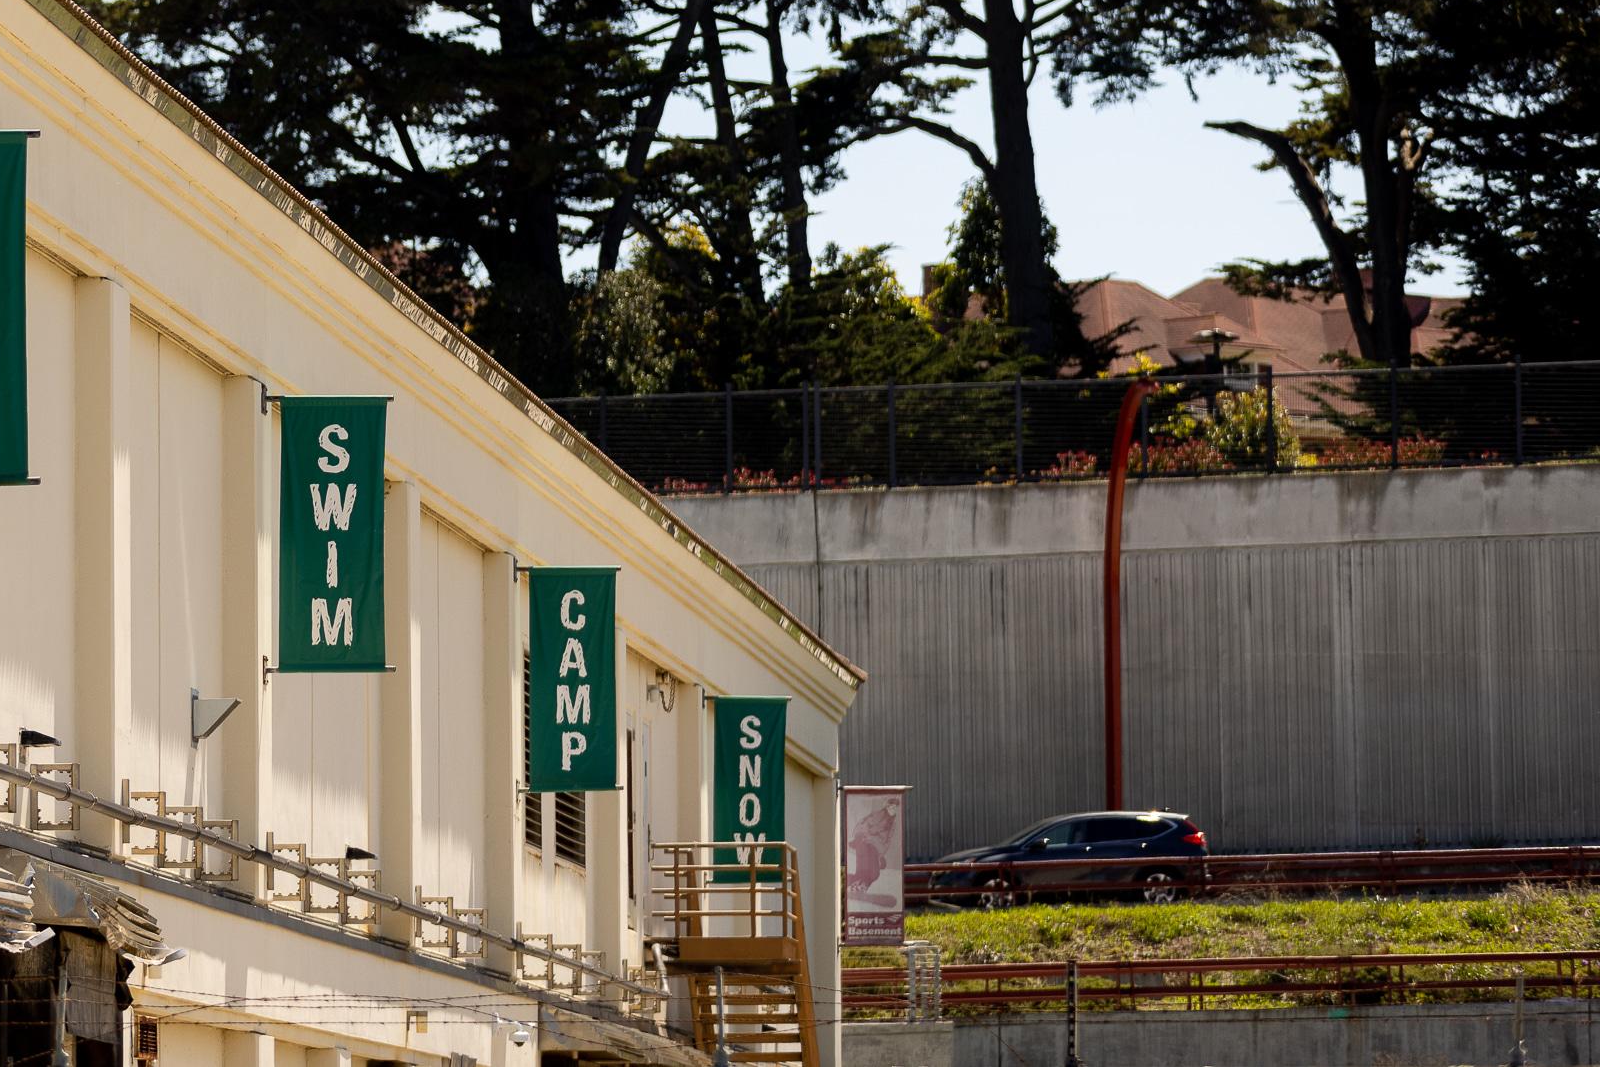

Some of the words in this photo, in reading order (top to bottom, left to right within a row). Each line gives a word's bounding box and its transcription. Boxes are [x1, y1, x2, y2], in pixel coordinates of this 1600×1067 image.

[310, 424, 357, 647] SWIM
[555, 589, 591, 772] CAMP
[733, 715, 766, 865] SNOW
[848, 916, 885, 927] Sports
[848, 926, 902, 935] Basement
